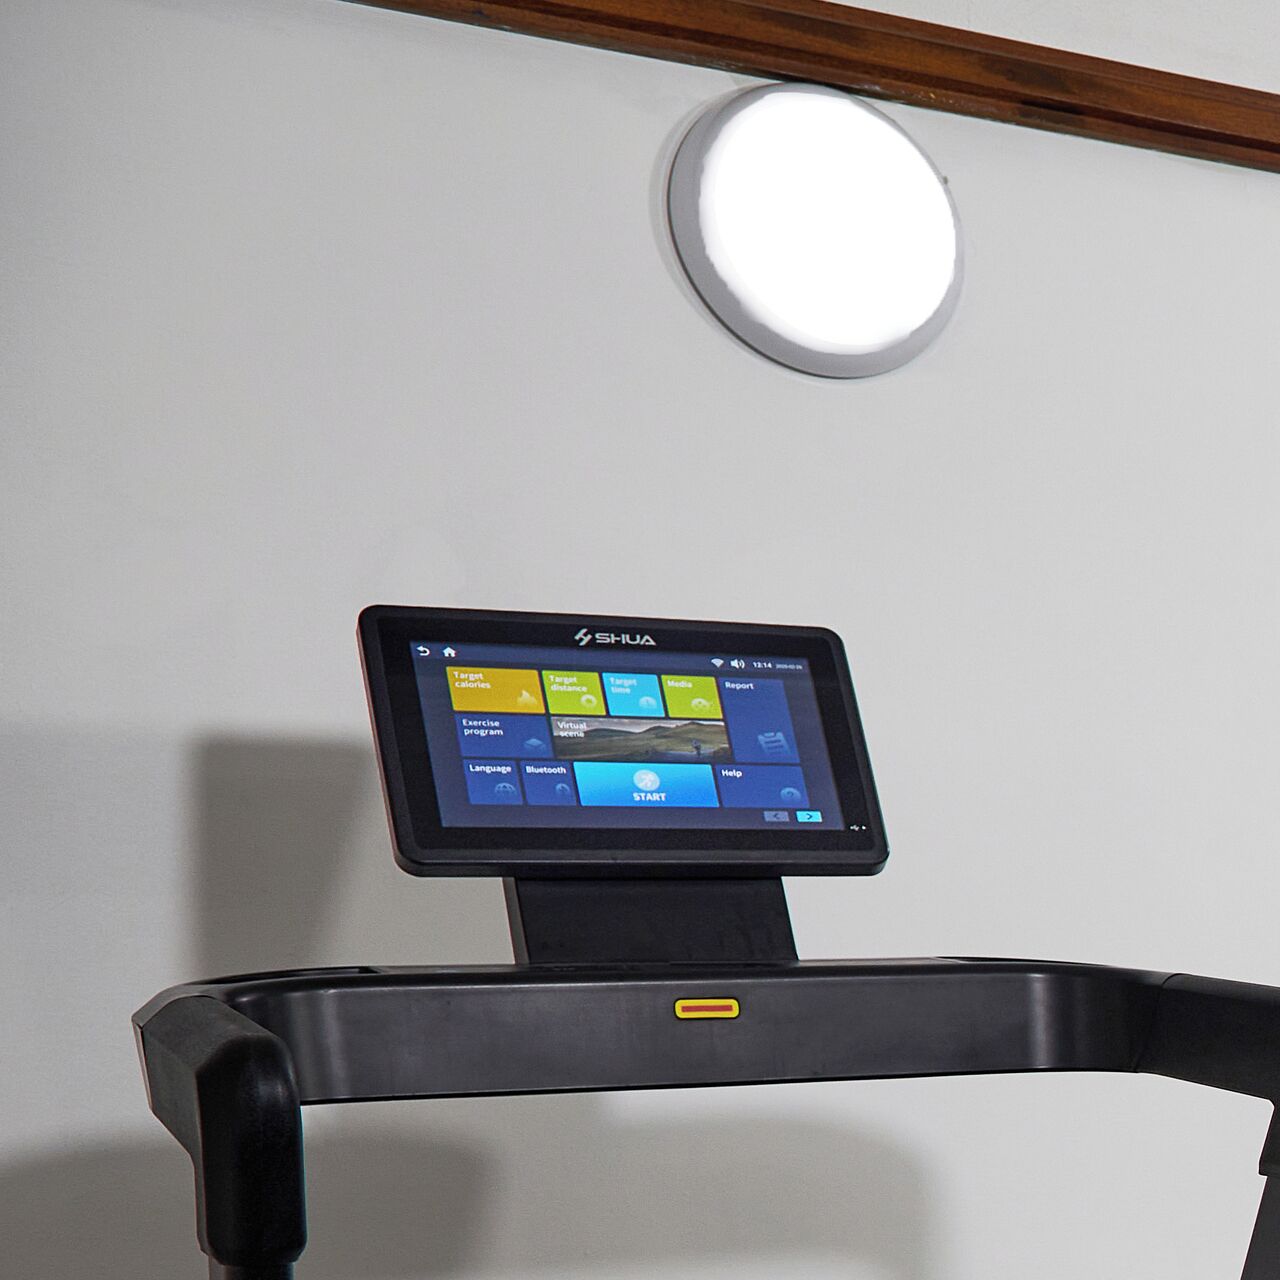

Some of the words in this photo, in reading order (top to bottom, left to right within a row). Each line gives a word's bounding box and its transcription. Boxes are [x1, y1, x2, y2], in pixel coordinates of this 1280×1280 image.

[594, 632, 657, 646] SHUA
[453, 671, 484, 681] Target
[549, 675, 578, 684] Target
[455, 680, 491, 689] calories
[609, 677, 638, 687] Target
[667, 679, 693, 688] Media
[724, 681, 755, 690] Report
[551, 684, 588, 692] distance
[610, 685, 632, 694] time
[462, 719, 500, 727] Exercise
[557, 721, 588, 730] Virtual
[464, 728, 504, 737] program
[469, 764, 512, 774] Language
[526, 766, 567, 775] Bluetooth
[721, 769, 743, 778] Help
[632, 792, 667, 802] START
